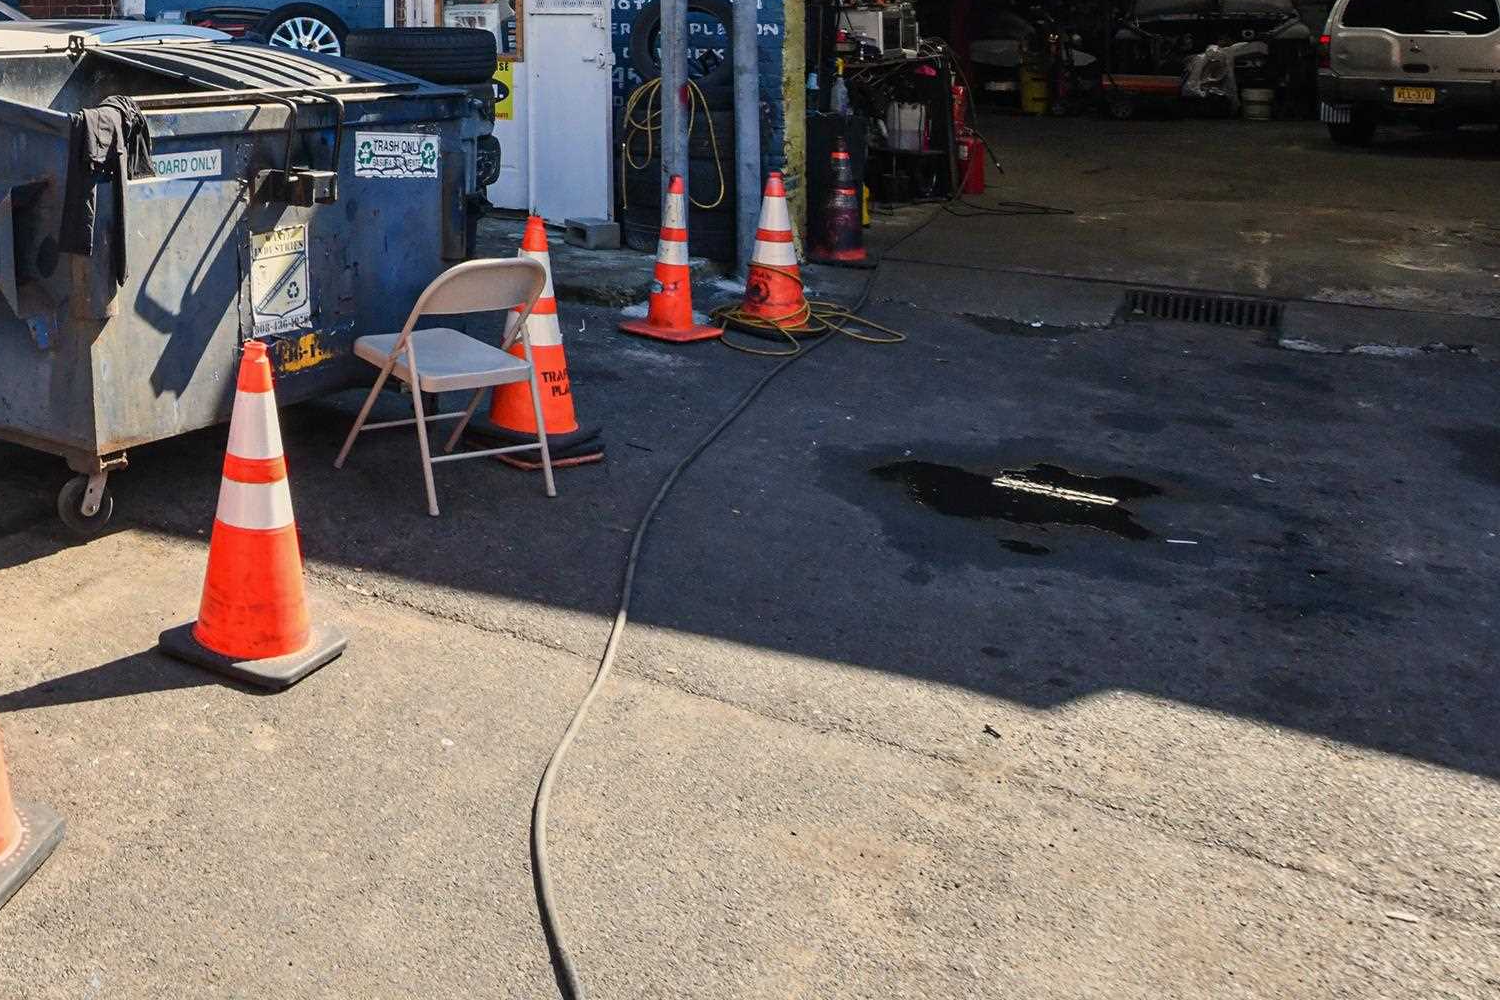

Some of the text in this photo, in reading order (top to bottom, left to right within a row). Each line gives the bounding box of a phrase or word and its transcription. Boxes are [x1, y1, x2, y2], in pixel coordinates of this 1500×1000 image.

[373, 140, 421, 153] TRASH ONLY
[191, 156, 217, 171] ONLY
